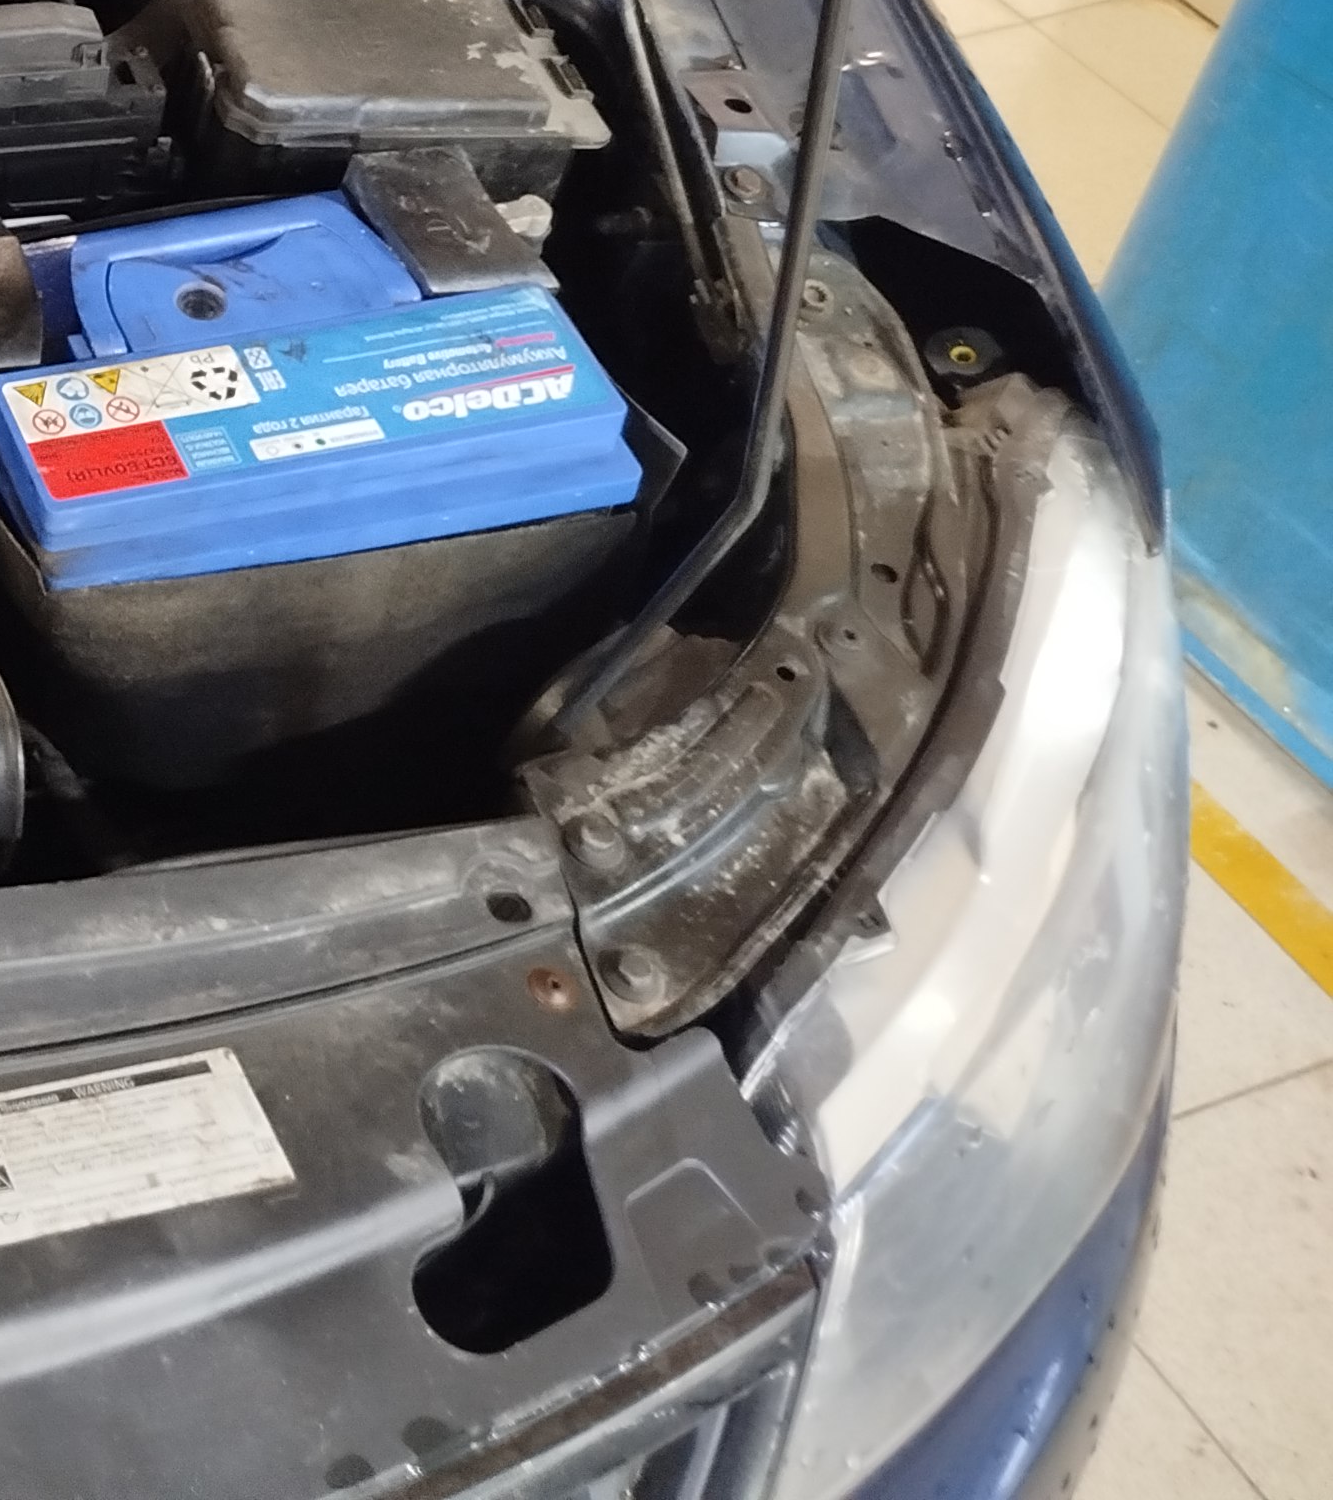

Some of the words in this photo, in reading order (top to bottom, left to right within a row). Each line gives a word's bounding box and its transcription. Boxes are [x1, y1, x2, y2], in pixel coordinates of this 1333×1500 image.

[190, 353, 215, 365] Pb
[383, 352, 427, 369] Battery
[412, 345, 567, 383] Аккумуляторная
[334, 376, 413, 398] батарея
[402, 373, 575, 421] ACDelco
[252, 419, 287, 434] года
[288, 417, 298, 428] 2
[300, 405, 370, 427] Гарантия
[71, 1075, 136, 1100] WARNING
